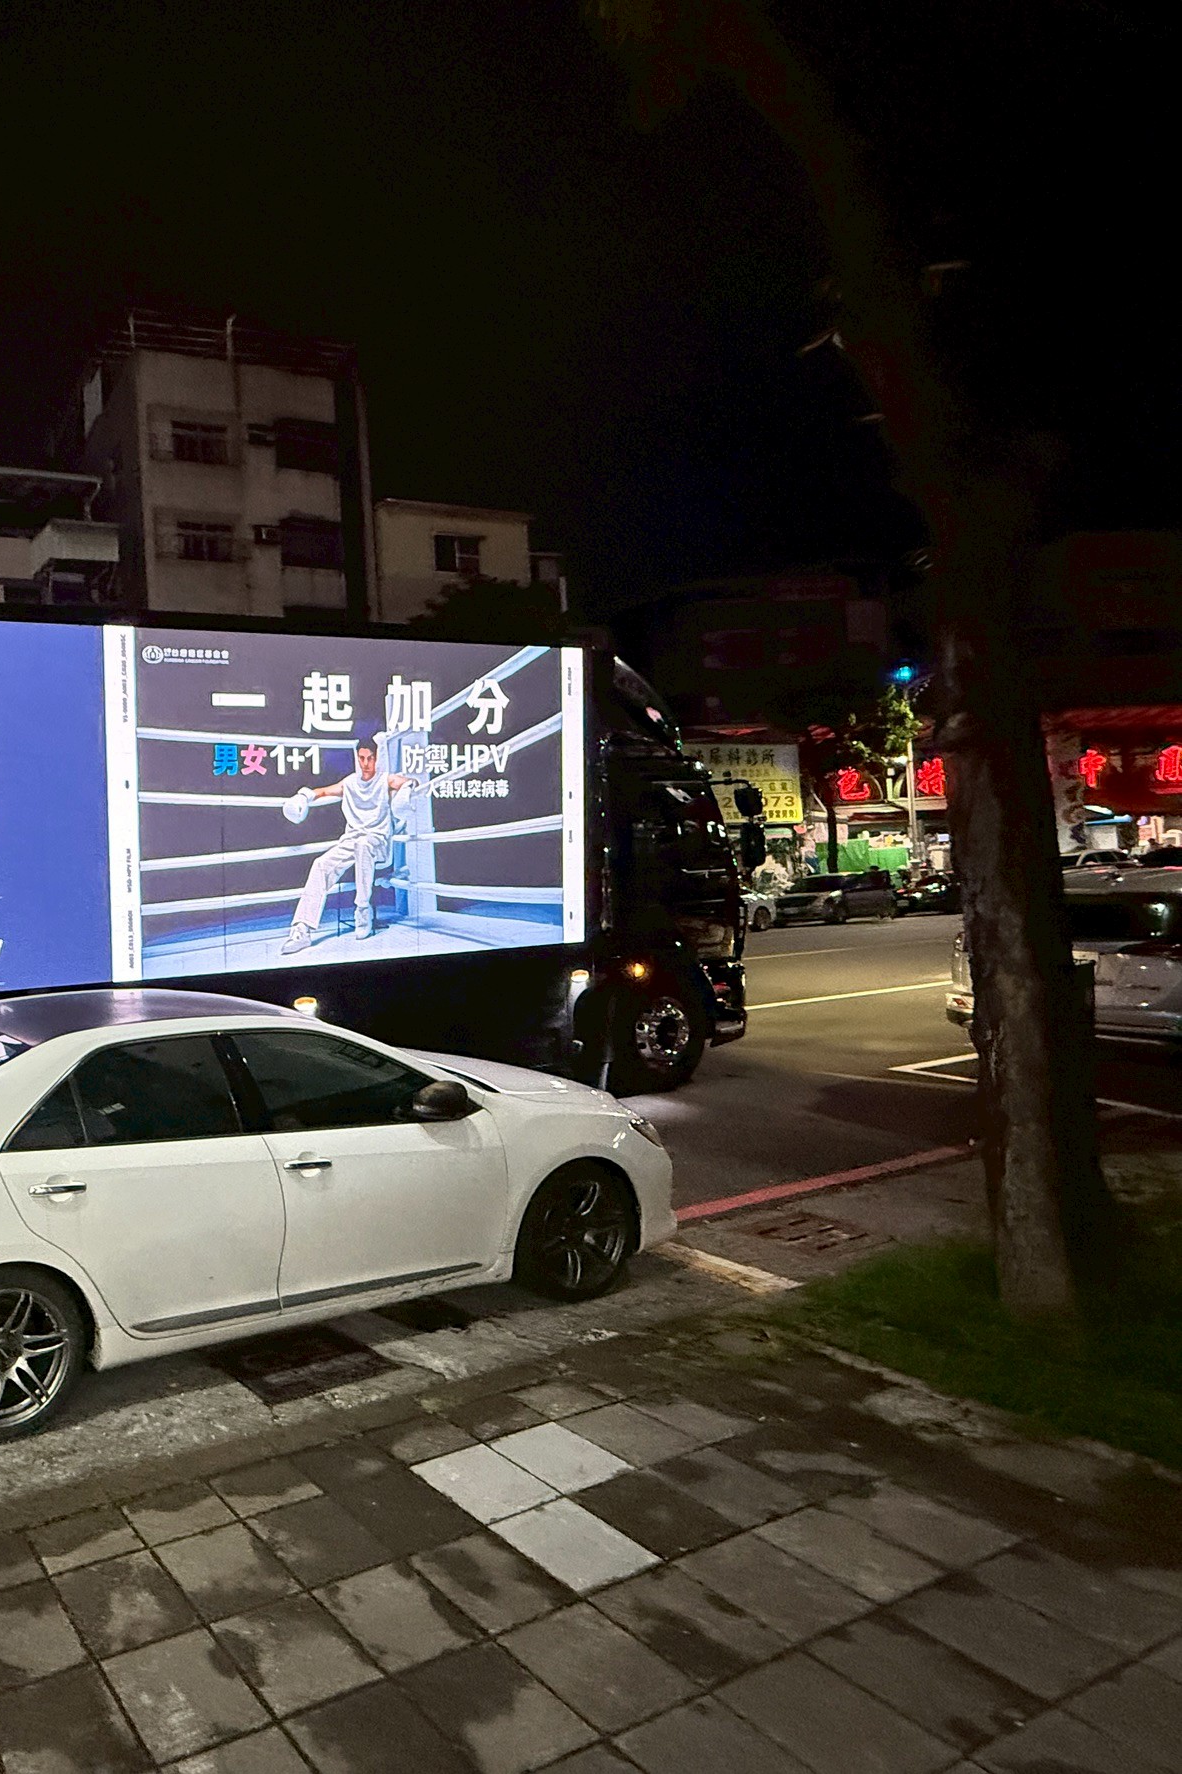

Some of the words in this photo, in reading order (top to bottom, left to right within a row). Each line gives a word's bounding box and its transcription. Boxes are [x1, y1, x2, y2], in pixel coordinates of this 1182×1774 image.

[402, 744, 511, 776] 防禦HPV
[425, 779, 510, 799] 人類乳突病毒
